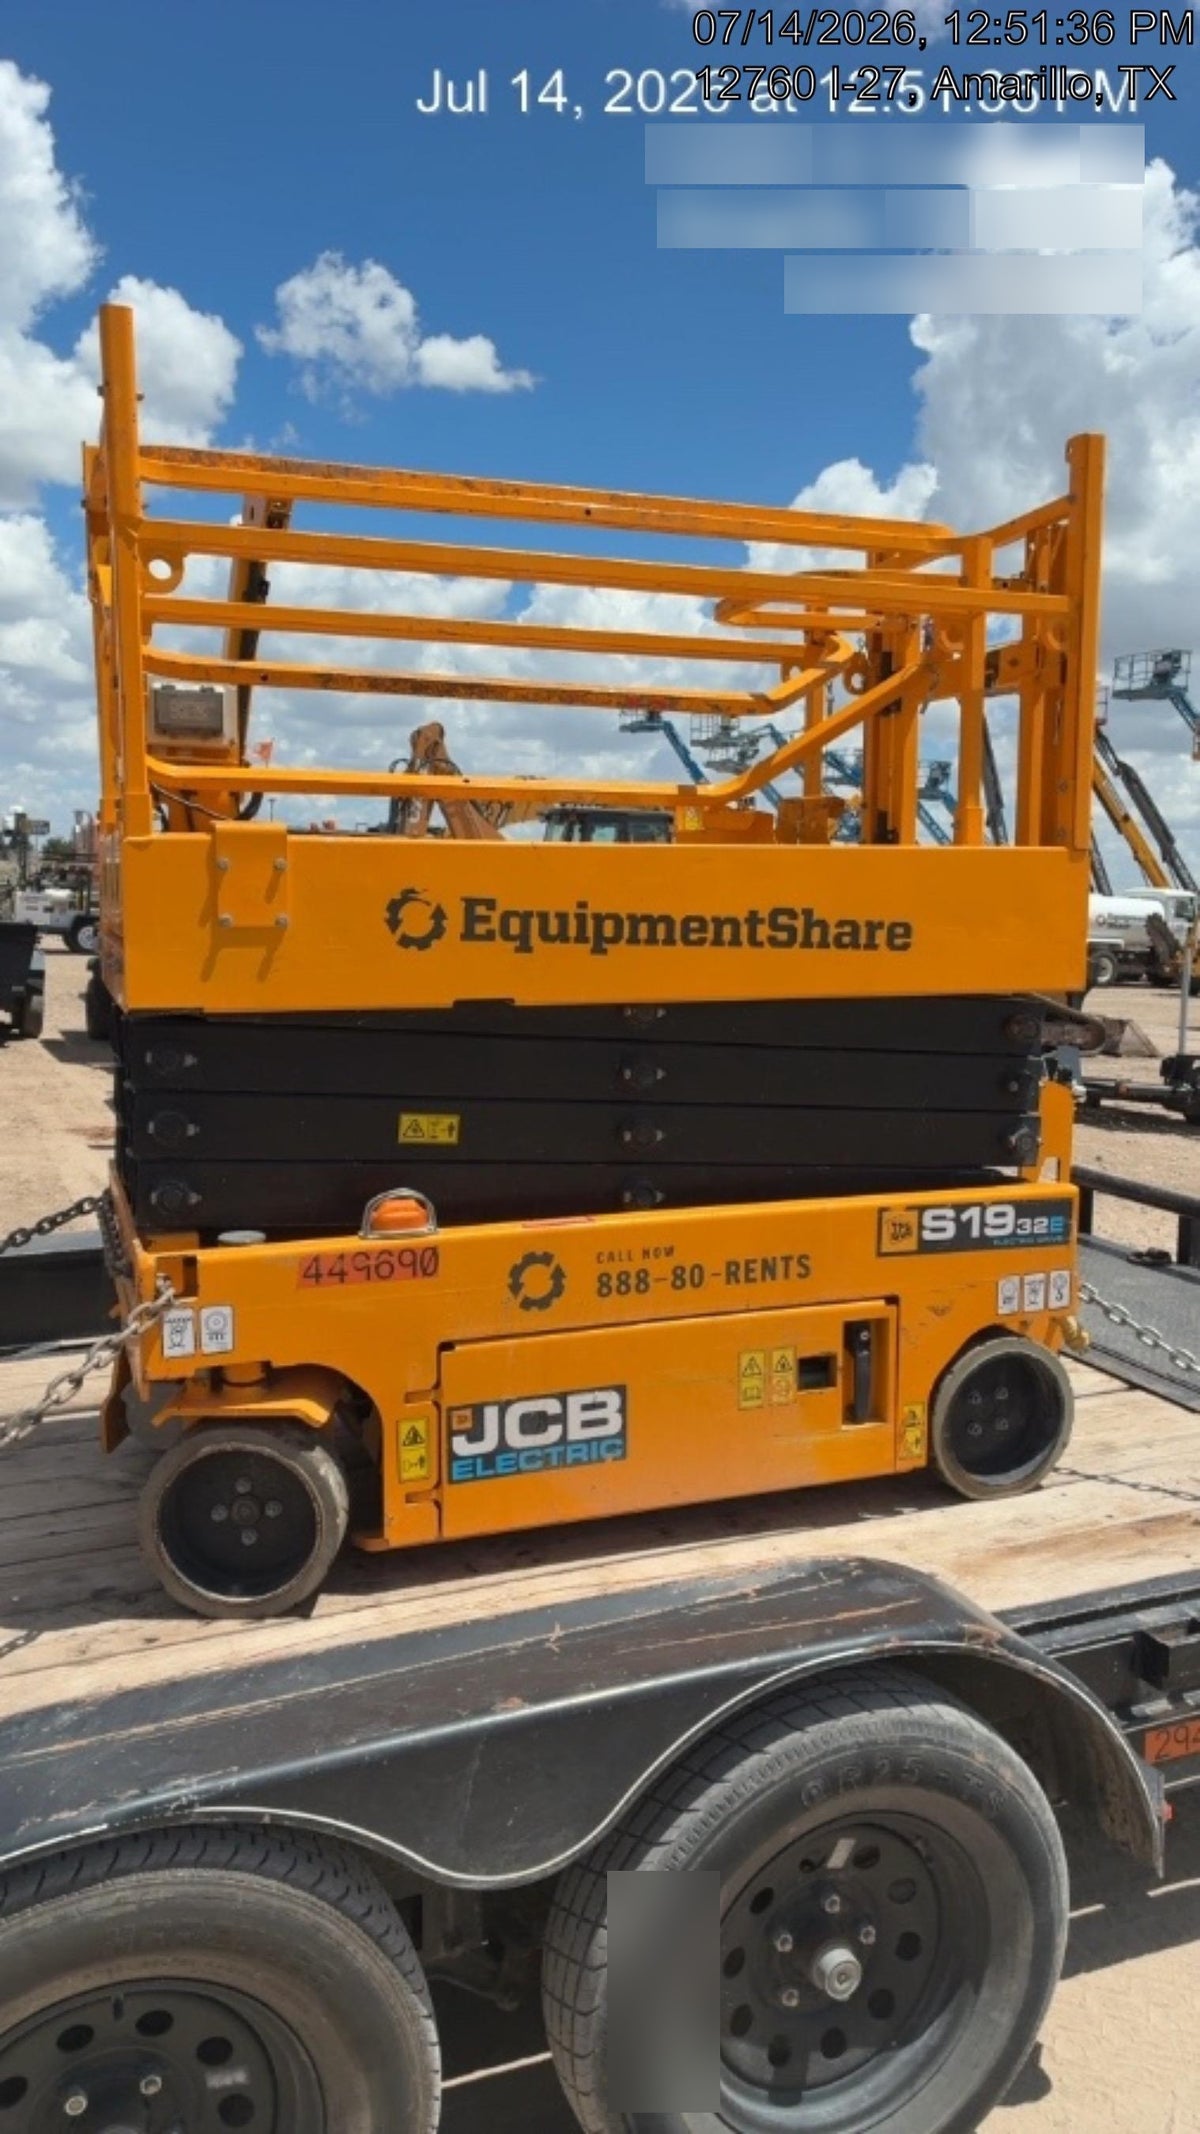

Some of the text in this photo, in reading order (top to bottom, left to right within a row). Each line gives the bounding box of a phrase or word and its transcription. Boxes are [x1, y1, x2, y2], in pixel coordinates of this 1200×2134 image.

[459, 896, 913, 955] EquipmentShare
[303, 1246, 439, 1285] 449690
[597, 1246, 675, 1264] CALL NOW
[452, 1390, 623, 1457] JCB
[452, 1438, 623, 1481] ELECTRIC
